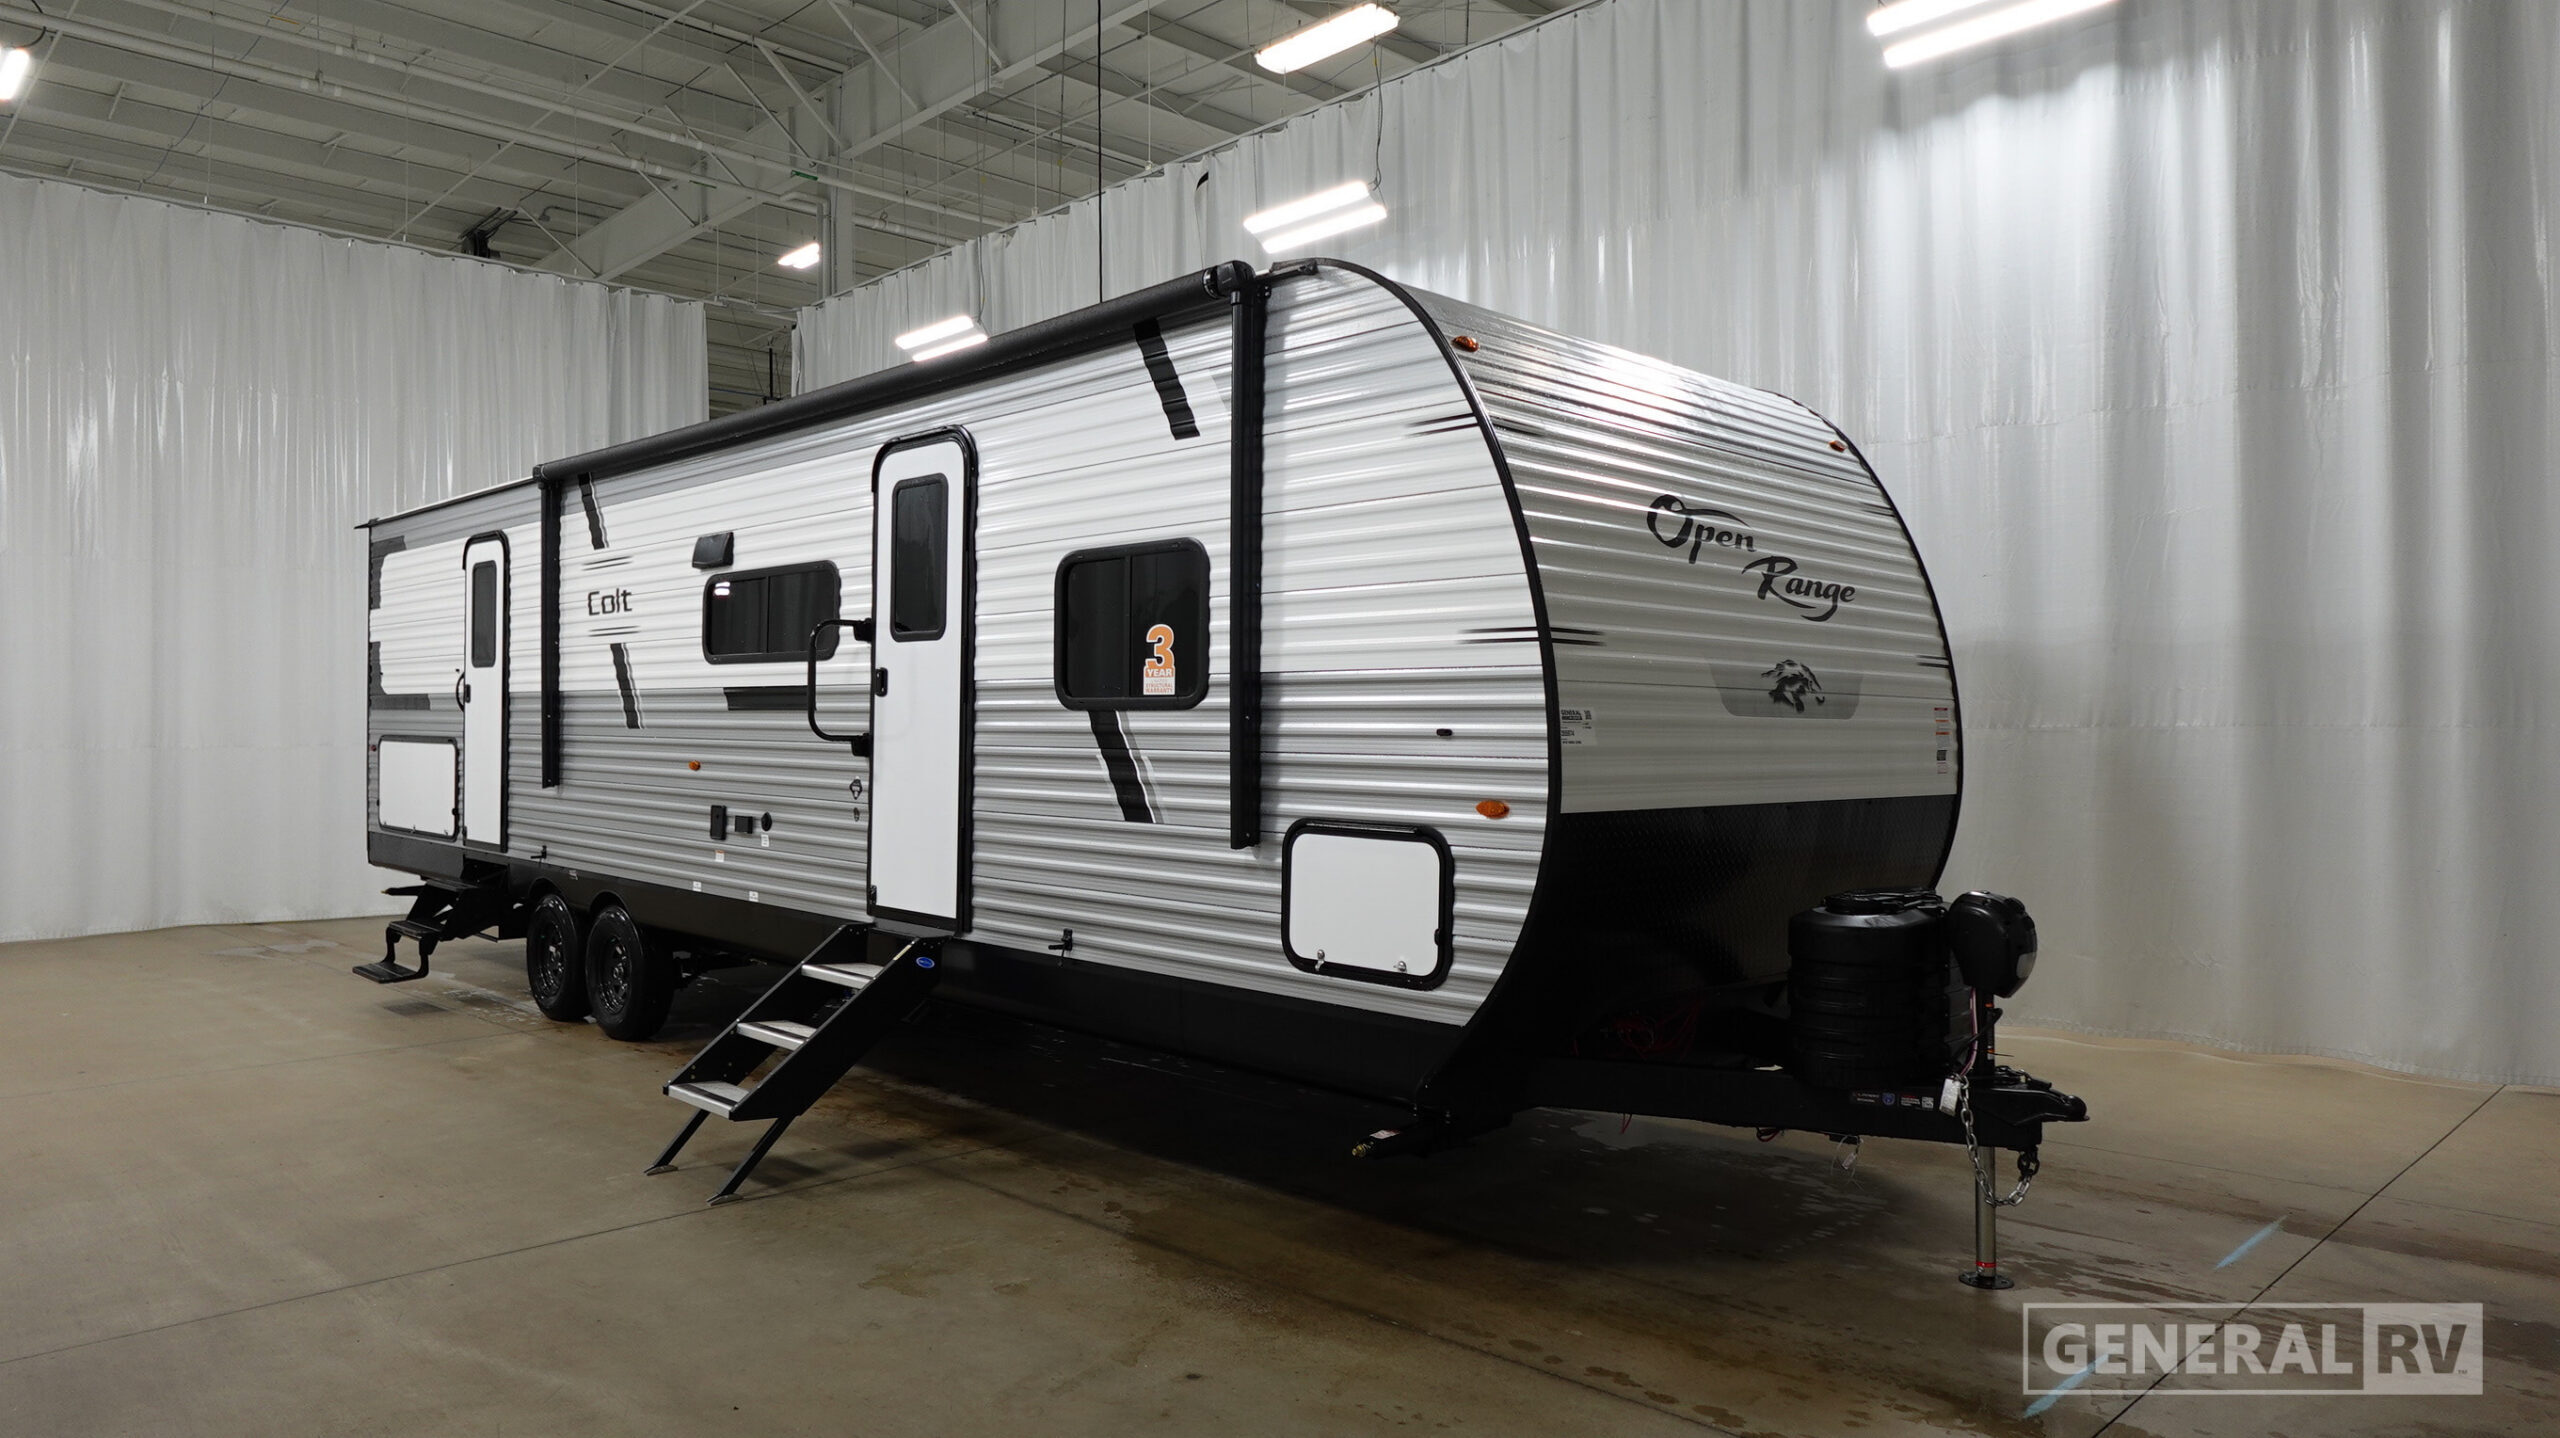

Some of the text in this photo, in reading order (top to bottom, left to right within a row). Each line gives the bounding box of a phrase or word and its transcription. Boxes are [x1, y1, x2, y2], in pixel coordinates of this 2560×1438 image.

[1646, 494, 1756, 564] Open
[587, 587, 633, 617] Colt
[1741, 555, 1856, 622] Range
[1146, 624, 1174, 668] 3
[1147, 668, 1172, 677] YEAR
